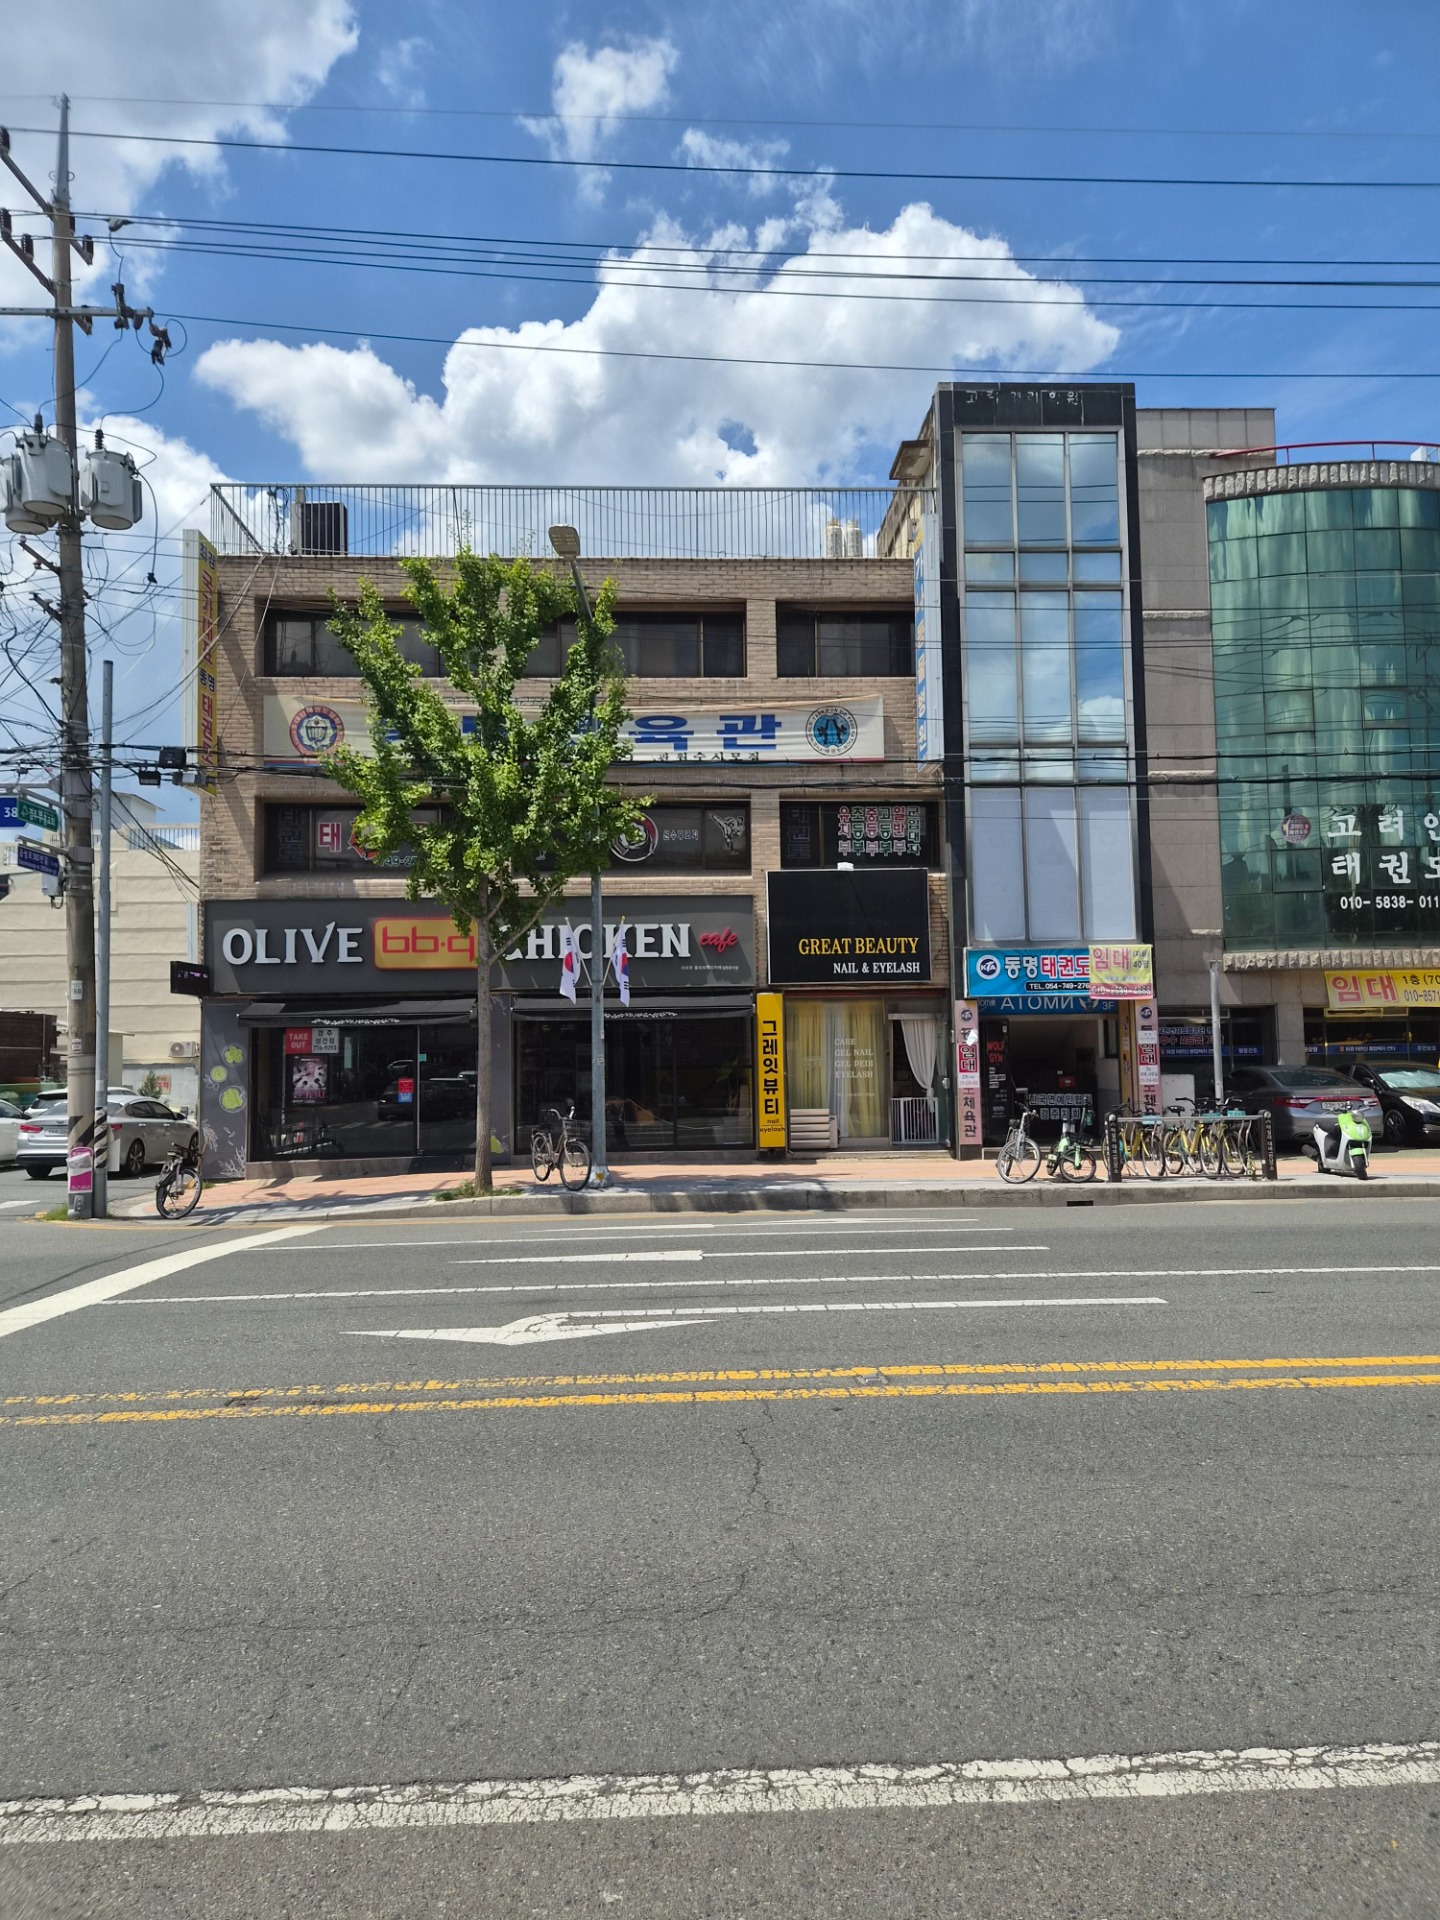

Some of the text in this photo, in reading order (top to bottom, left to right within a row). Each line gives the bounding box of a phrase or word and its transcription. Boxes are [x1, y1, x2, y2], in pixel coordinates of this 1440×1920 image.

[223, 921, 363, 965] OLIVE
[699, 926, 739, 954] cafe
[798, 937, 919, 955] GREAT BEAUTY
[1092, 947, 1129, 970] 임대
[833, 962, 920, 974] NAIL & EYELASH
[1331, 975, 1398, 1003] 임대
[1102, 1001, 1114, 1010] 3F
[835, 1038, 857, 1046] CARE
[835, 1049, 851, 1057] GEL
[961, 1046, 975, 1071] 임대
[1142, 1043, 1156, 1064] 임대
[762, 1020, 779, 1115] 그레잇뷰티
[835, 1060, 851, 1068] GEL
[835, 1071, 873, 1079] EYELASH
